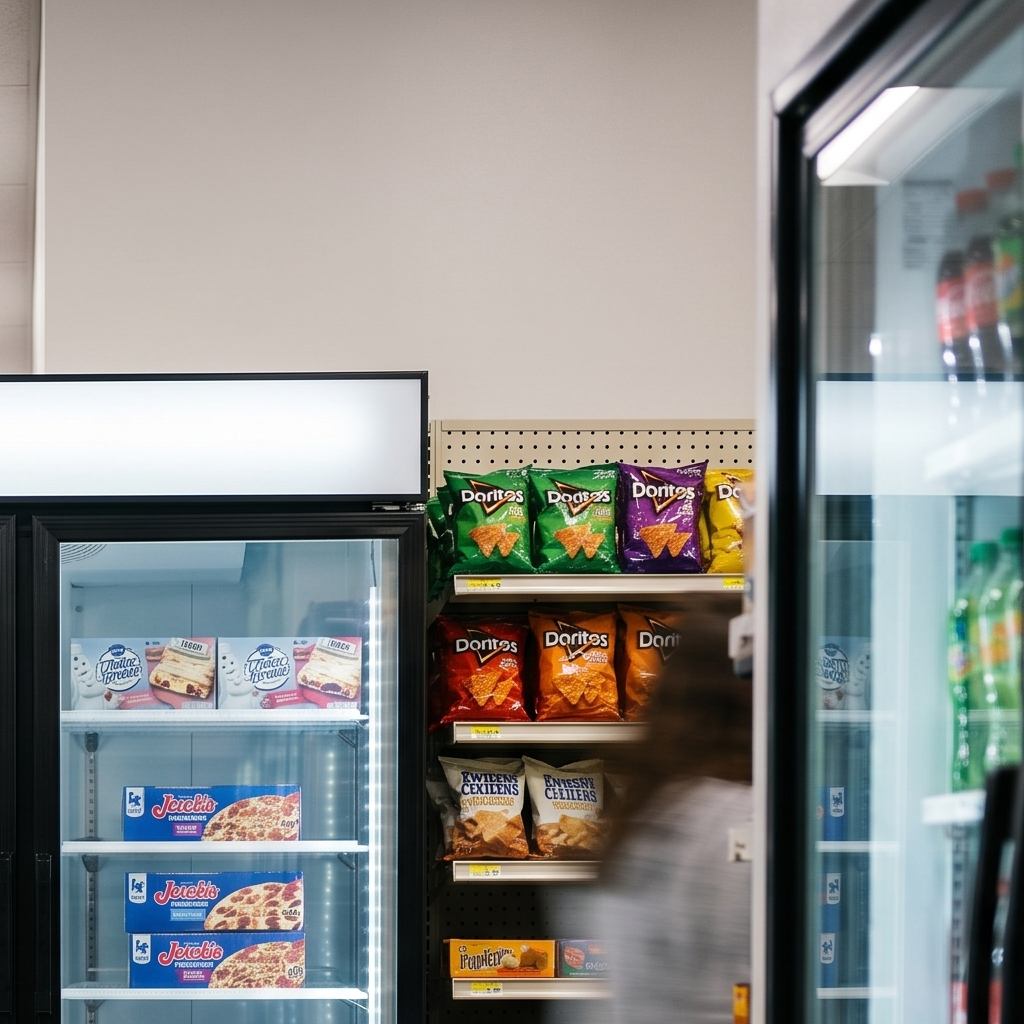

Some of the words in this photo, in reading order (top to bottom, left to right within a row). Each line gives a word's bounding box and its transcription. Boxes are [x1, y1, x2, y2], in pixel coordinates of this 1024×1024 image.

[461, 489, 524, 503] Doritos
[633, 482, 695, 500] Doritos
[545, 631, 608, 648] Doritos
